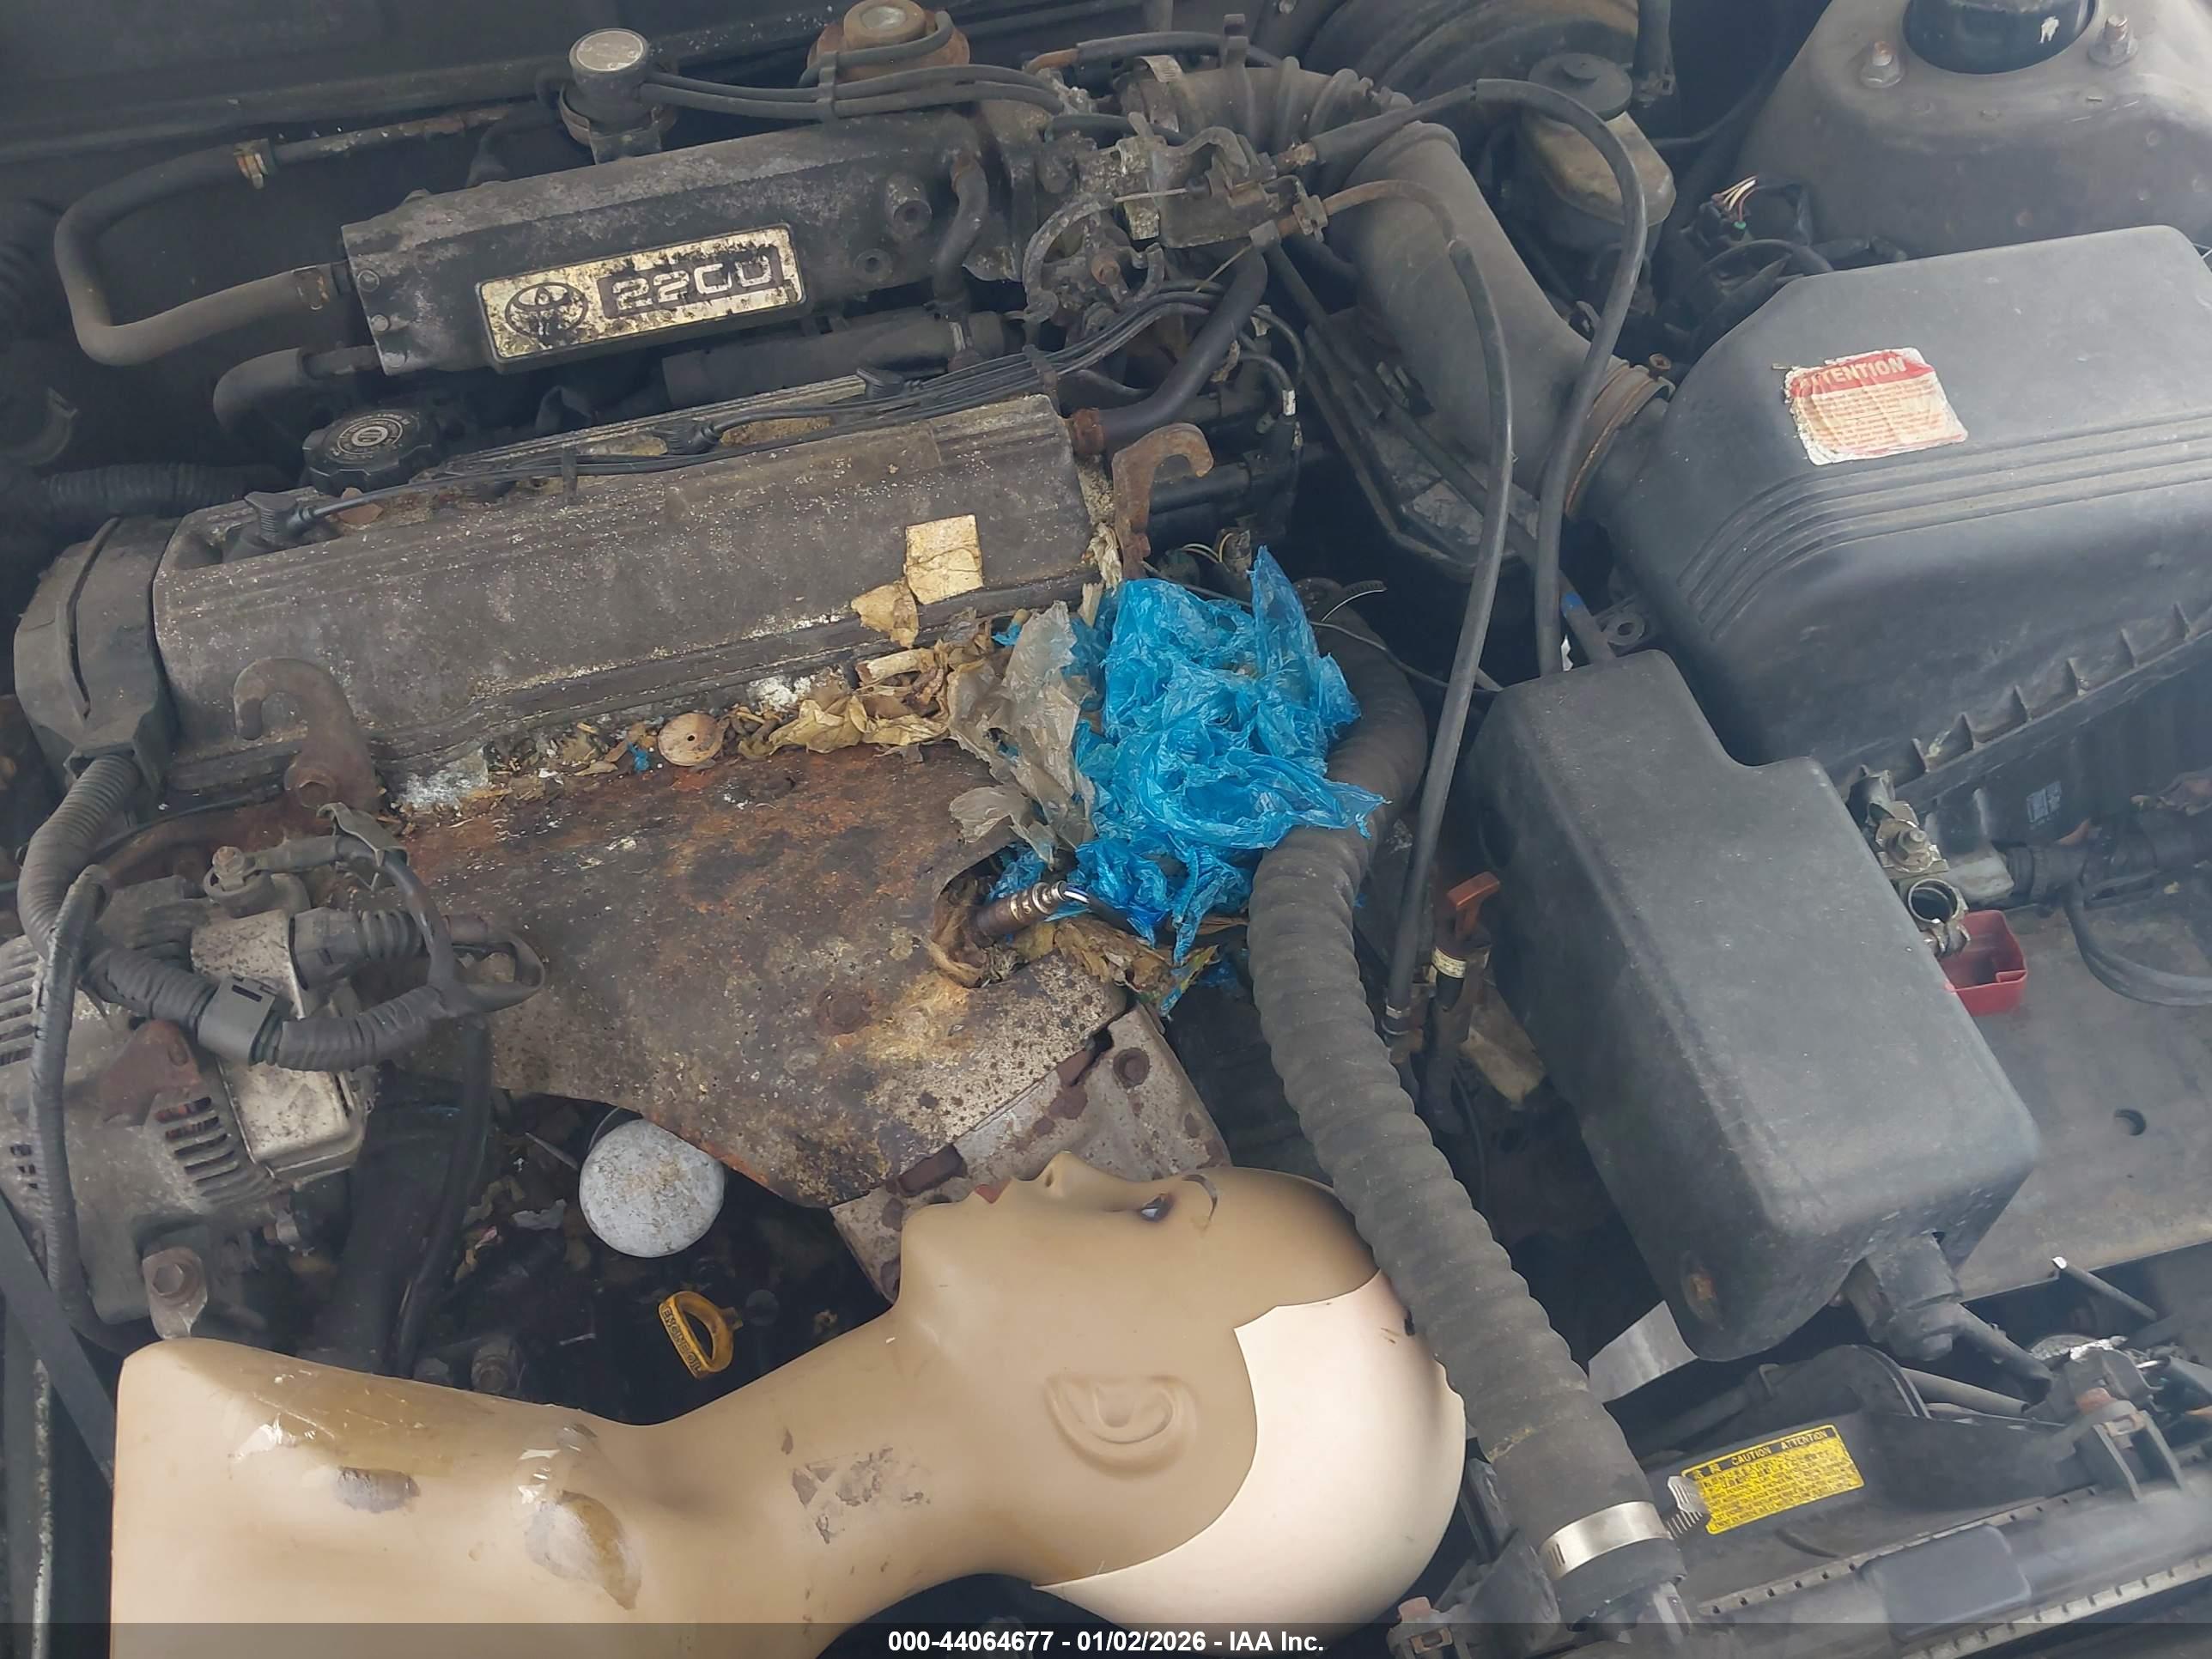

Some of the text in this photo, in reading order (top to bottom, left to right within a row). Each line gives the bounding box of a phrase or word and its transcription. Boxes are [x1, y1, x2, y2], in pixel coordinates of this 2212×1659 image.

[662, 1306, 702, 1373] ENGINE OIL
[1731, 1429, 1829, 1467] CAUTION ATTENTION
